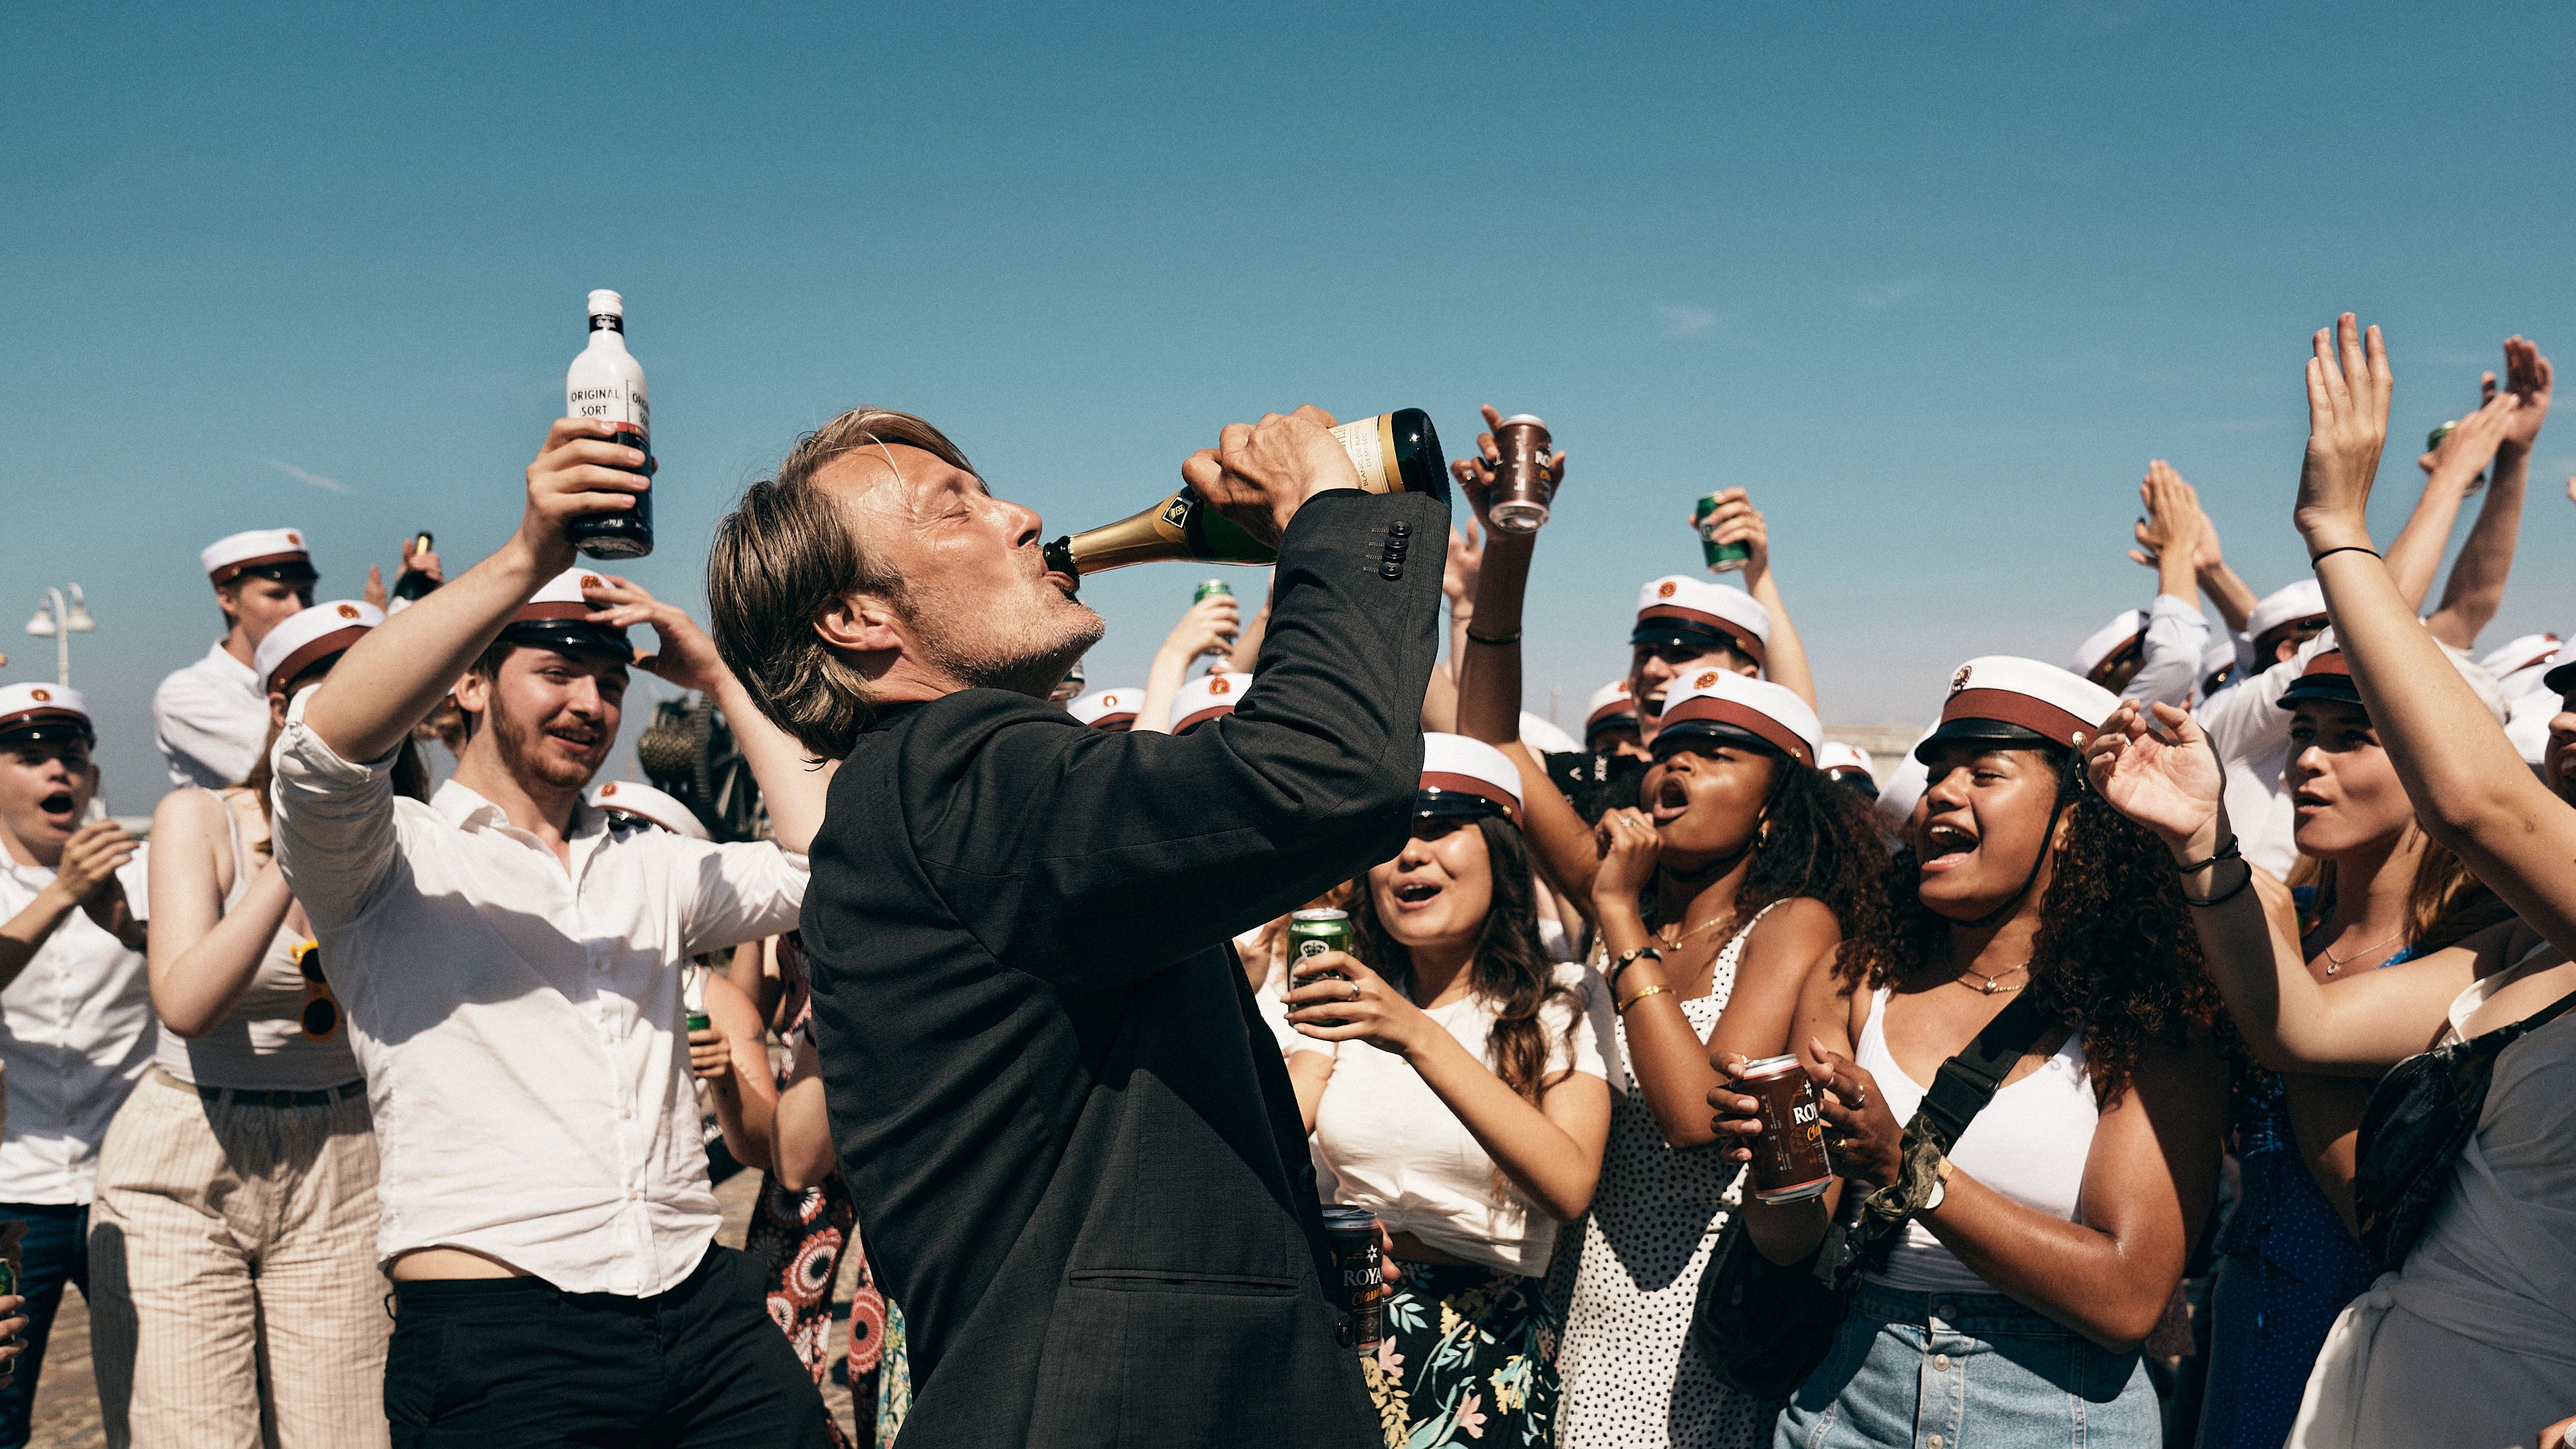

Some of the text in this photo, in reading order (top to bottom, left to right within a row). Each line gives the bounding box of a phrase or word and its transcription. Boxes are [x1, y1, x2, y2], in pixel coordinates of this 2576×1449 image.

[572, 389, 620, 402] ORIGINAL
[582, 405, 606, 416] SORT
[1356, 447, 1362, 457] DE
[1362, 433, 1371, 467] DEMI-SEC
[1358, 460, 1368, 486] BLANC
